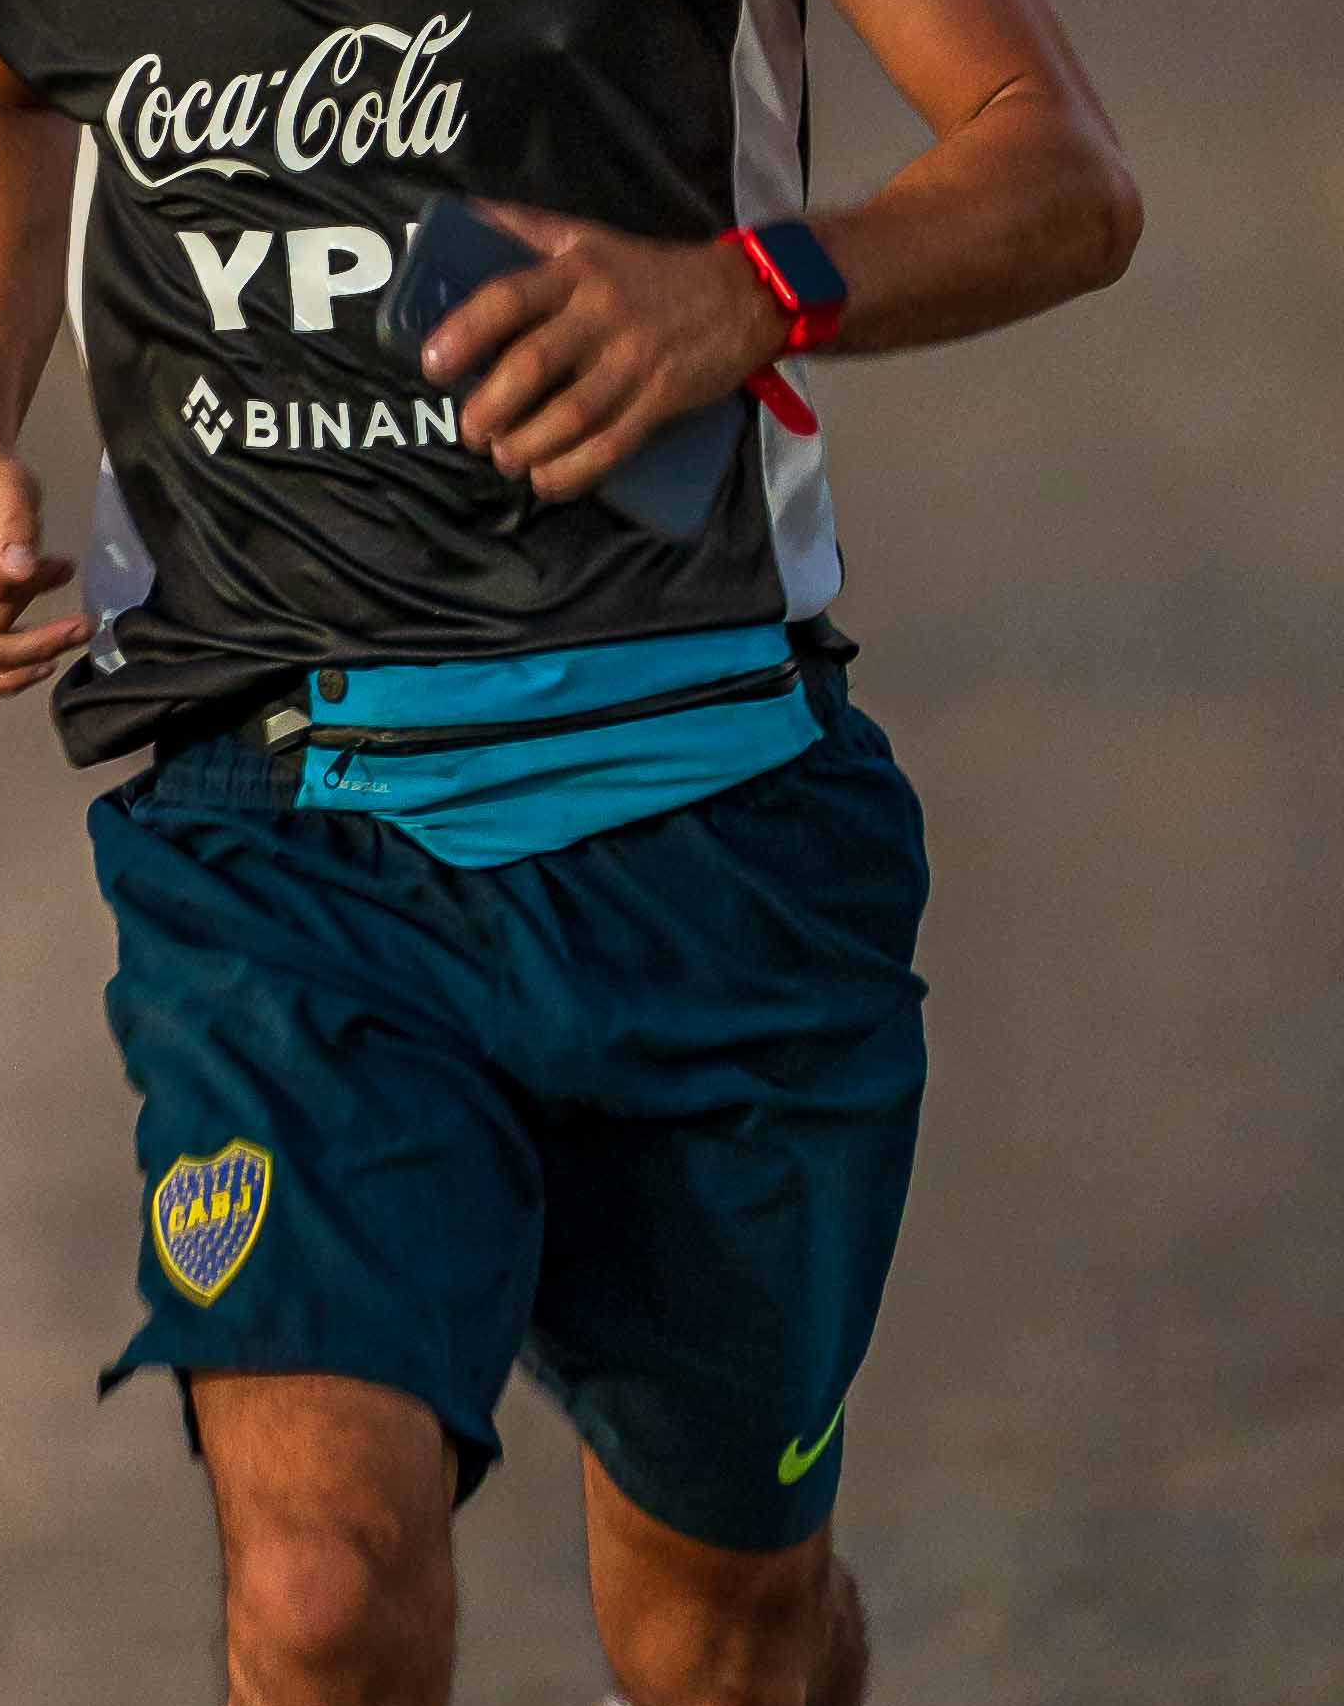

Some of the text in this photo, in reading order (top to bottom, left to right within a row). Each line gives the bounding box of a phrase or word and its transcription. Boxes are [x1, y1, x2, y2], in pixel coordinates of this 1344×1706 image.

[106, 11, 471, 187] Coca-Cola
[175, 223, 422, 331] YP
[243, 397, 457, 449] BINAN
[168, 1184, 252, 1233] CABJ
